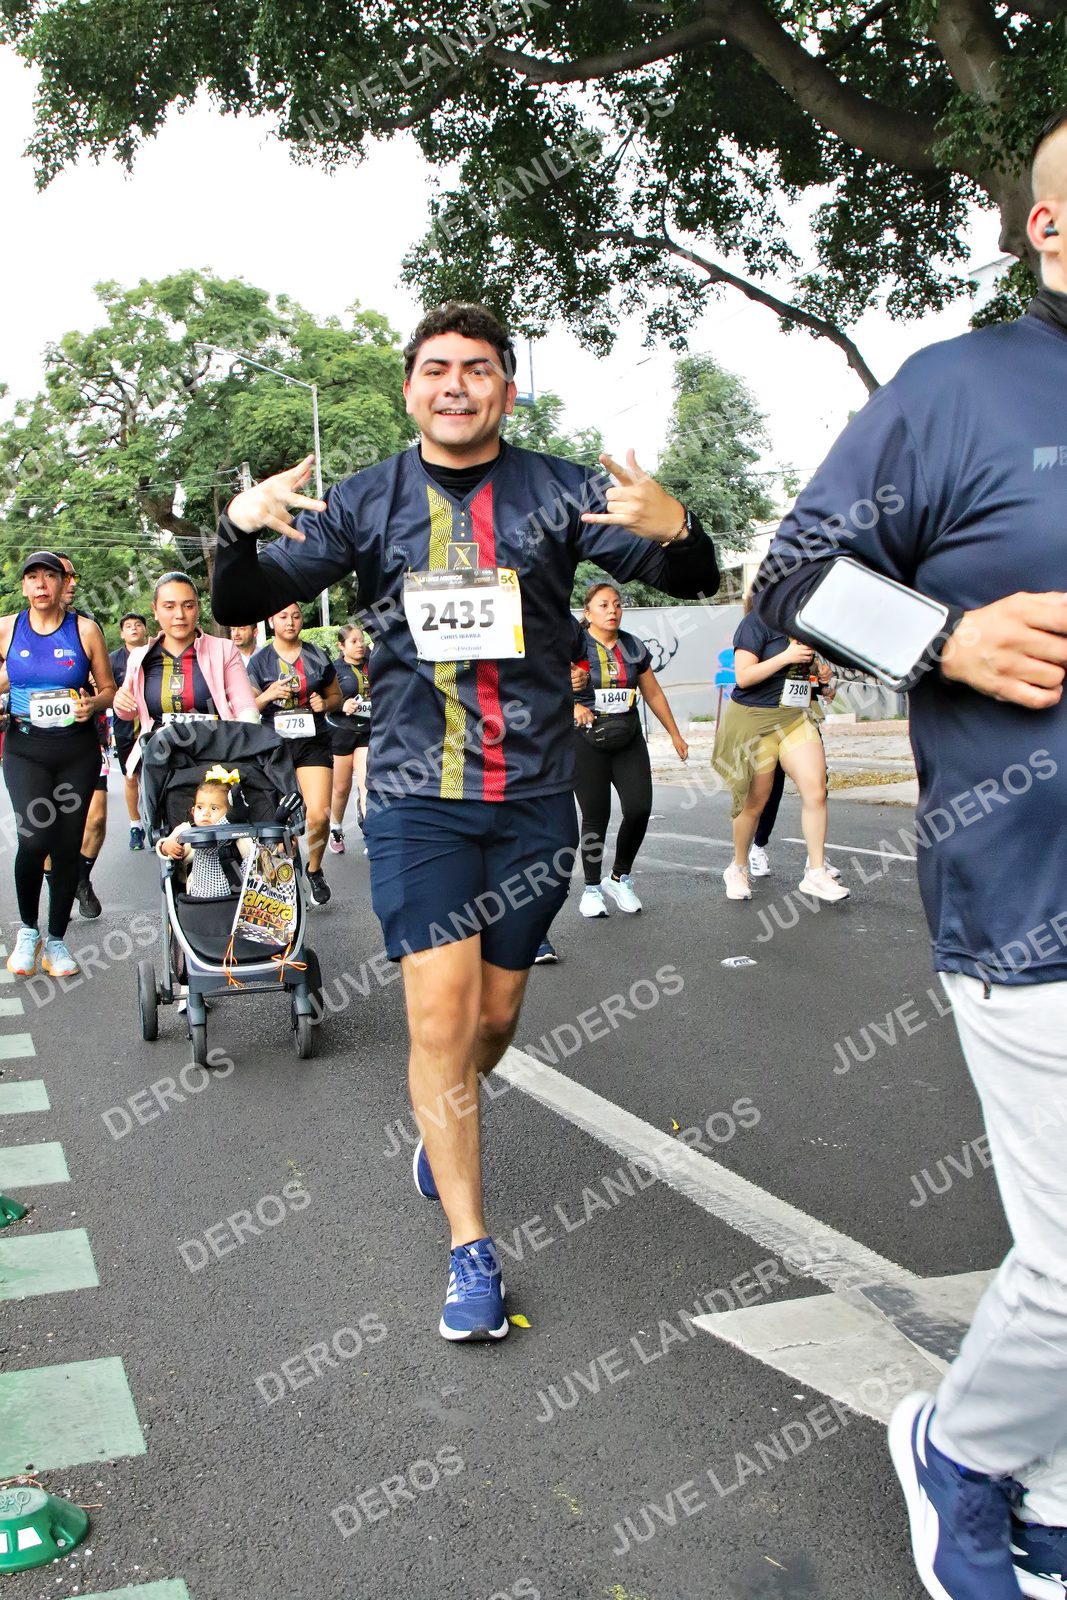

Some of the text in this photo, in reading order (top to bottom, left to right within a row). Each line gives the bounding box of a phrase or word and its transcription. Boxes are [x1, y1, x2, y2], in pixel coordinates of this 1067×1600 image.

[420, 599, 495, 631] 2435
[789, 684, 809, 695] 7308
[602, 691, 627, 703] 1840
[37, 704, 70, 718] 3060
[285, 718, 305, 729] 778
